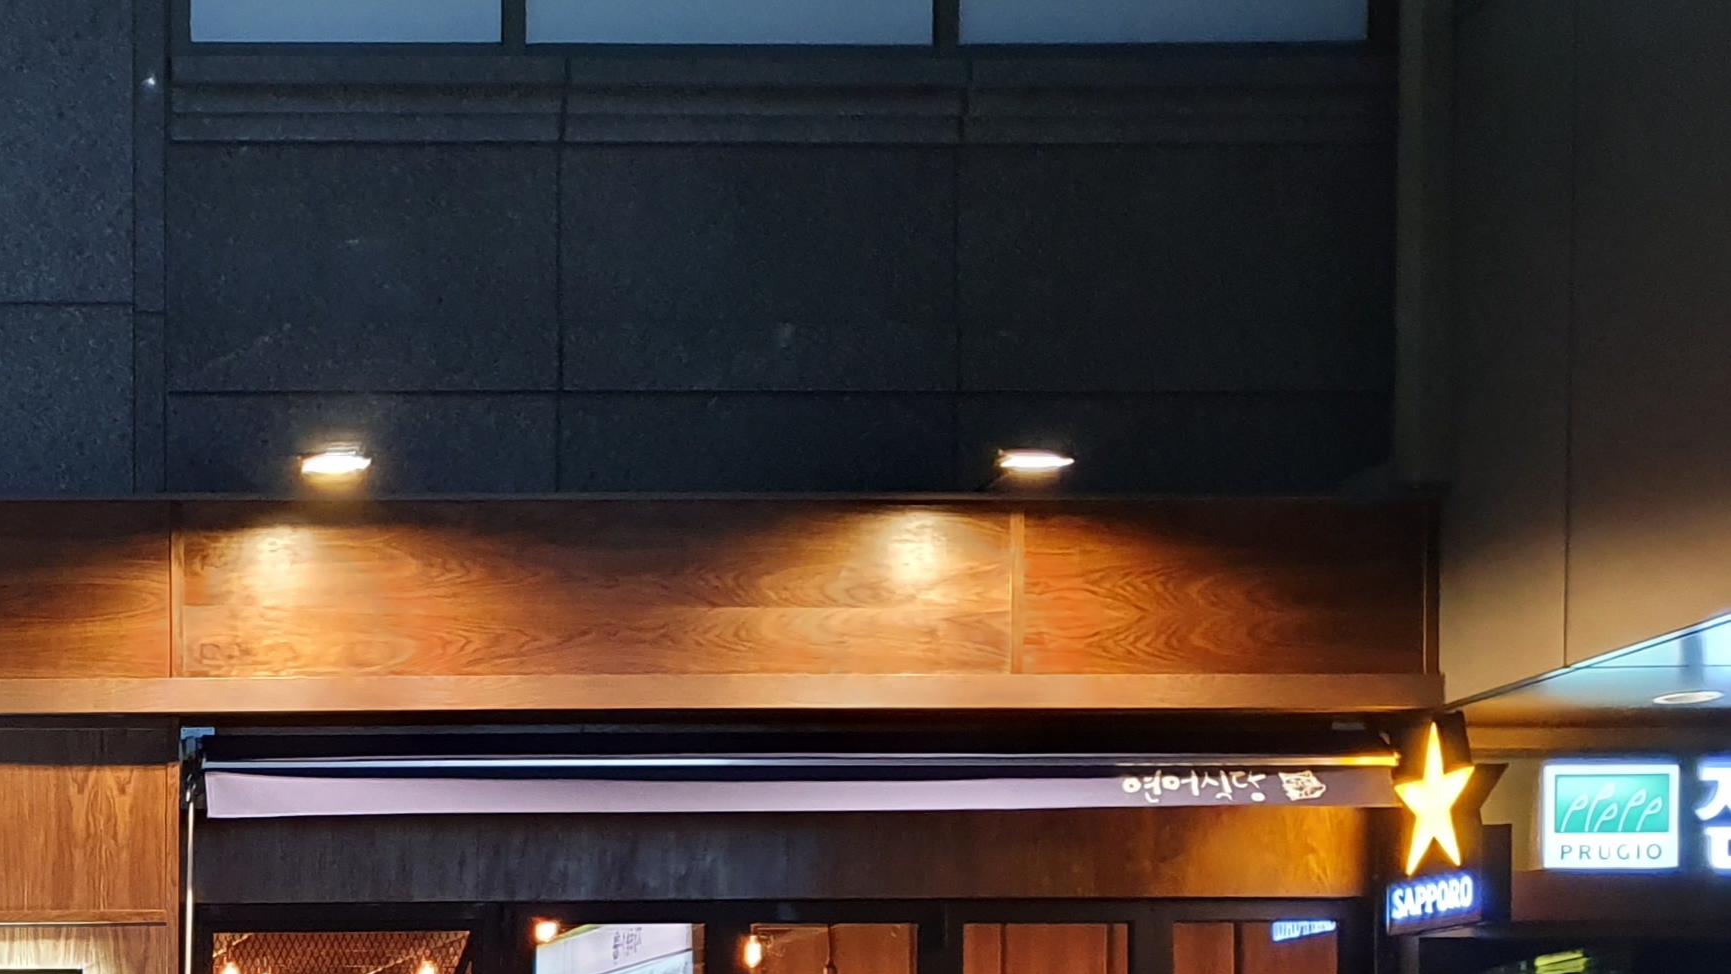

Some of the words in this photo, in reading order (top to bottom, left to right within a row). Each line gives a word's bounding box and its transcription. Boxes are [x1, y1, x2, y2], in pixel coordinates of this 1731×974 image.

[1122, 769, 1266, 804] 연어식당
[1560, 844, 1663, 861] PRUGIO
[1391, 875, 1473, 919] SAPPORO
